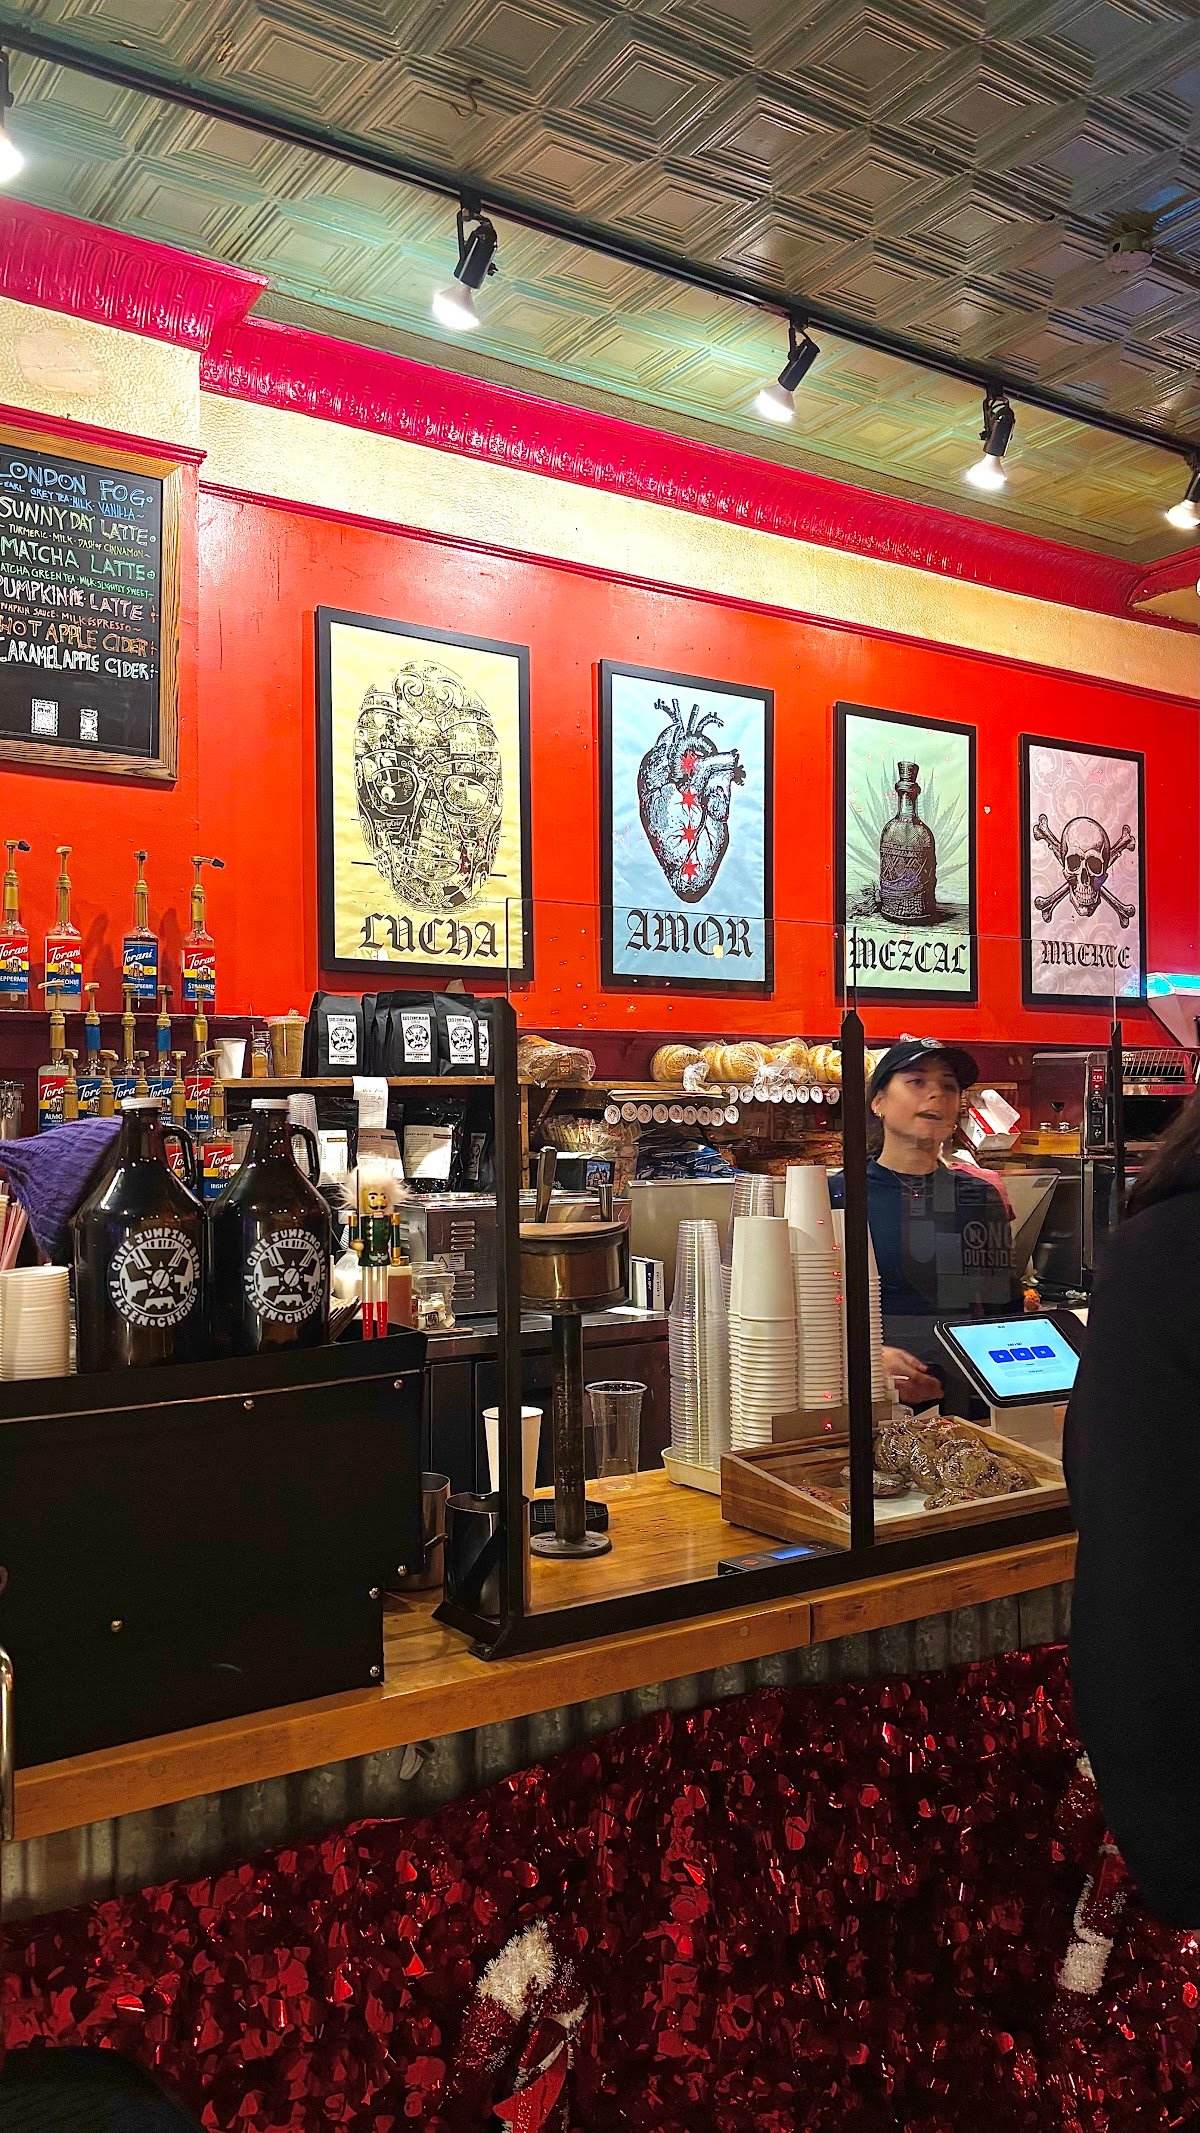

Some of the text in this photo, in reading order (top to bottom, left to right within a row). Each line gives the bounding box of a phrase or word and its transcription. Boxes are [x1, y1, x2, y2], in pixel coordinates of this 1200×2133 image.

[3, 480, 26, 493] EARL
[30, 487, 54, 501] GREY
[98, 501, 136, 520] VANILLA
[99, 479, 145, 508] FOG
[0, 496, 148, 546] SUNNY DAY LATTE
[0, 535, 146, 581] MATCHA LATTE
[8, 523, 48, 538] TURMERIC
[52, 532, 74, 545] MILK
[78, 538, 94, 550] DASH
[103, 543, 144, 559] CINNAMON
[0, 562, 31, 577] ATCHA
[31, 568, 62, 581] GREEN
[63, 573, 76, 584] TEA
[97, 580, 125, 594] SLIGHTLY
[126, 586, 148, 599] SWEET
[32, 607, 56, 618] SAUCE
[61, 612, 86, 627] MILK
[87, 616, 131, 632] ESPRESSO
[89, 592, 144, 621] LATTE
[0, 614, 149, 658] HOT APPLE CIDER
[62, 648, 100, 673] APPLE
[104, 657, 149, 681] CIDER
[358, 912, 499, 961] LUCHA
[625, 909, 753, 958] AMOR
[49, 945, 81, 965] Torani
[124, 948, 153, 966] Torani
[848, 937, 968, 975] MEZCAL
[1041, 939, 1132, 970] MUERTE
[41, 1082, 65, 1102] Tora
[78, 1083, 101, 1102] Tora
[113, 1083, 136, 1102] Tora
[148, 1083, 172, 1098] Tora
[187, 1083, 211, 1101] Tora
[111, 1227, 201, 1279] CAFE JUMPING BEAN
[246, 1228, 326, 1280] CAFE JUMPING BEAN
[109, 1280, 198, 1328] PILSEN CHICAGO
[243, 1274, 324, 1324] PILSEN CHICAGO
